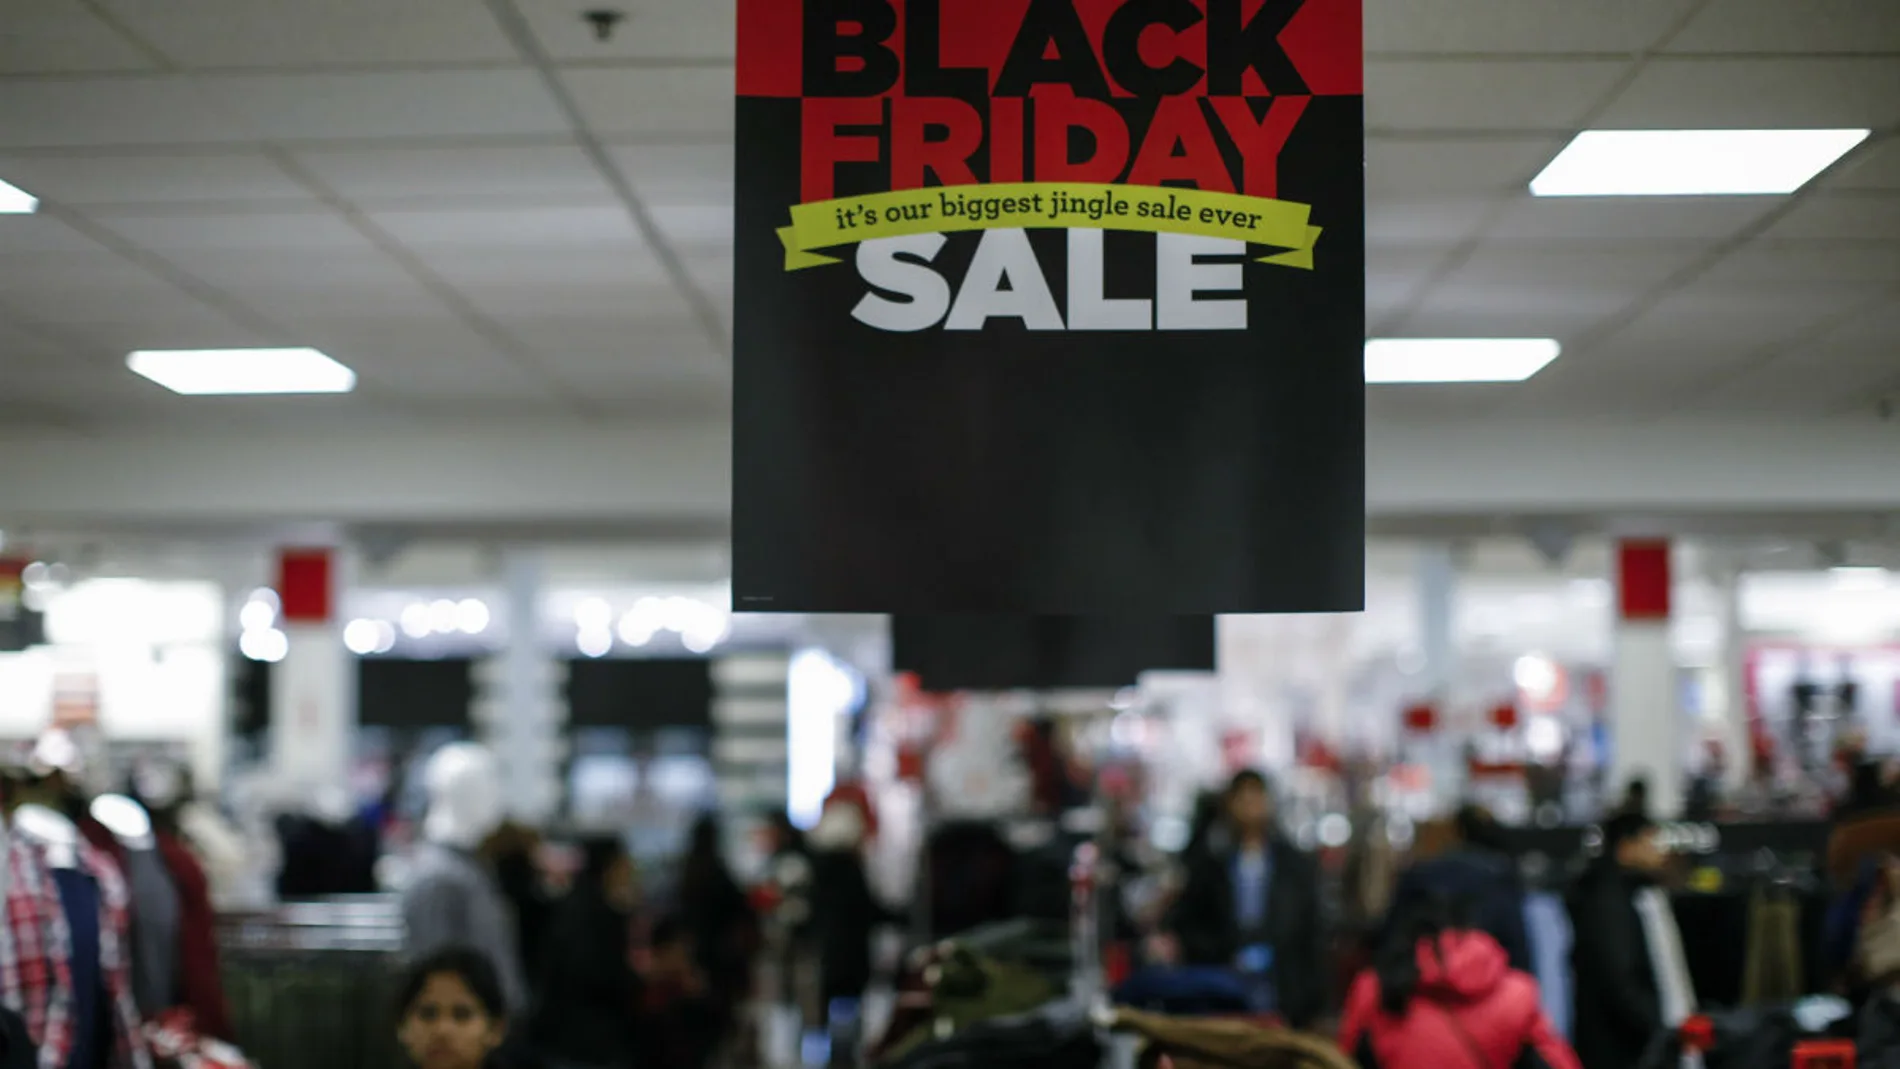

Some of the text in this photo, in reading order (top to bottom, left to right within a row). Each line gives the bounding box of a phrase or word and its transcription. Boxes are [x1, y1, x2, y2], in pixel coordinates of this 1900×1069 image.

[802, 0, 1311, 97] BLACK
[801, 96, 1312, 200] FRIDAY
[836, 190, 1262, 230] it’s our biggest jingle sale ever
[850, 228, 1248, 332] SALE
